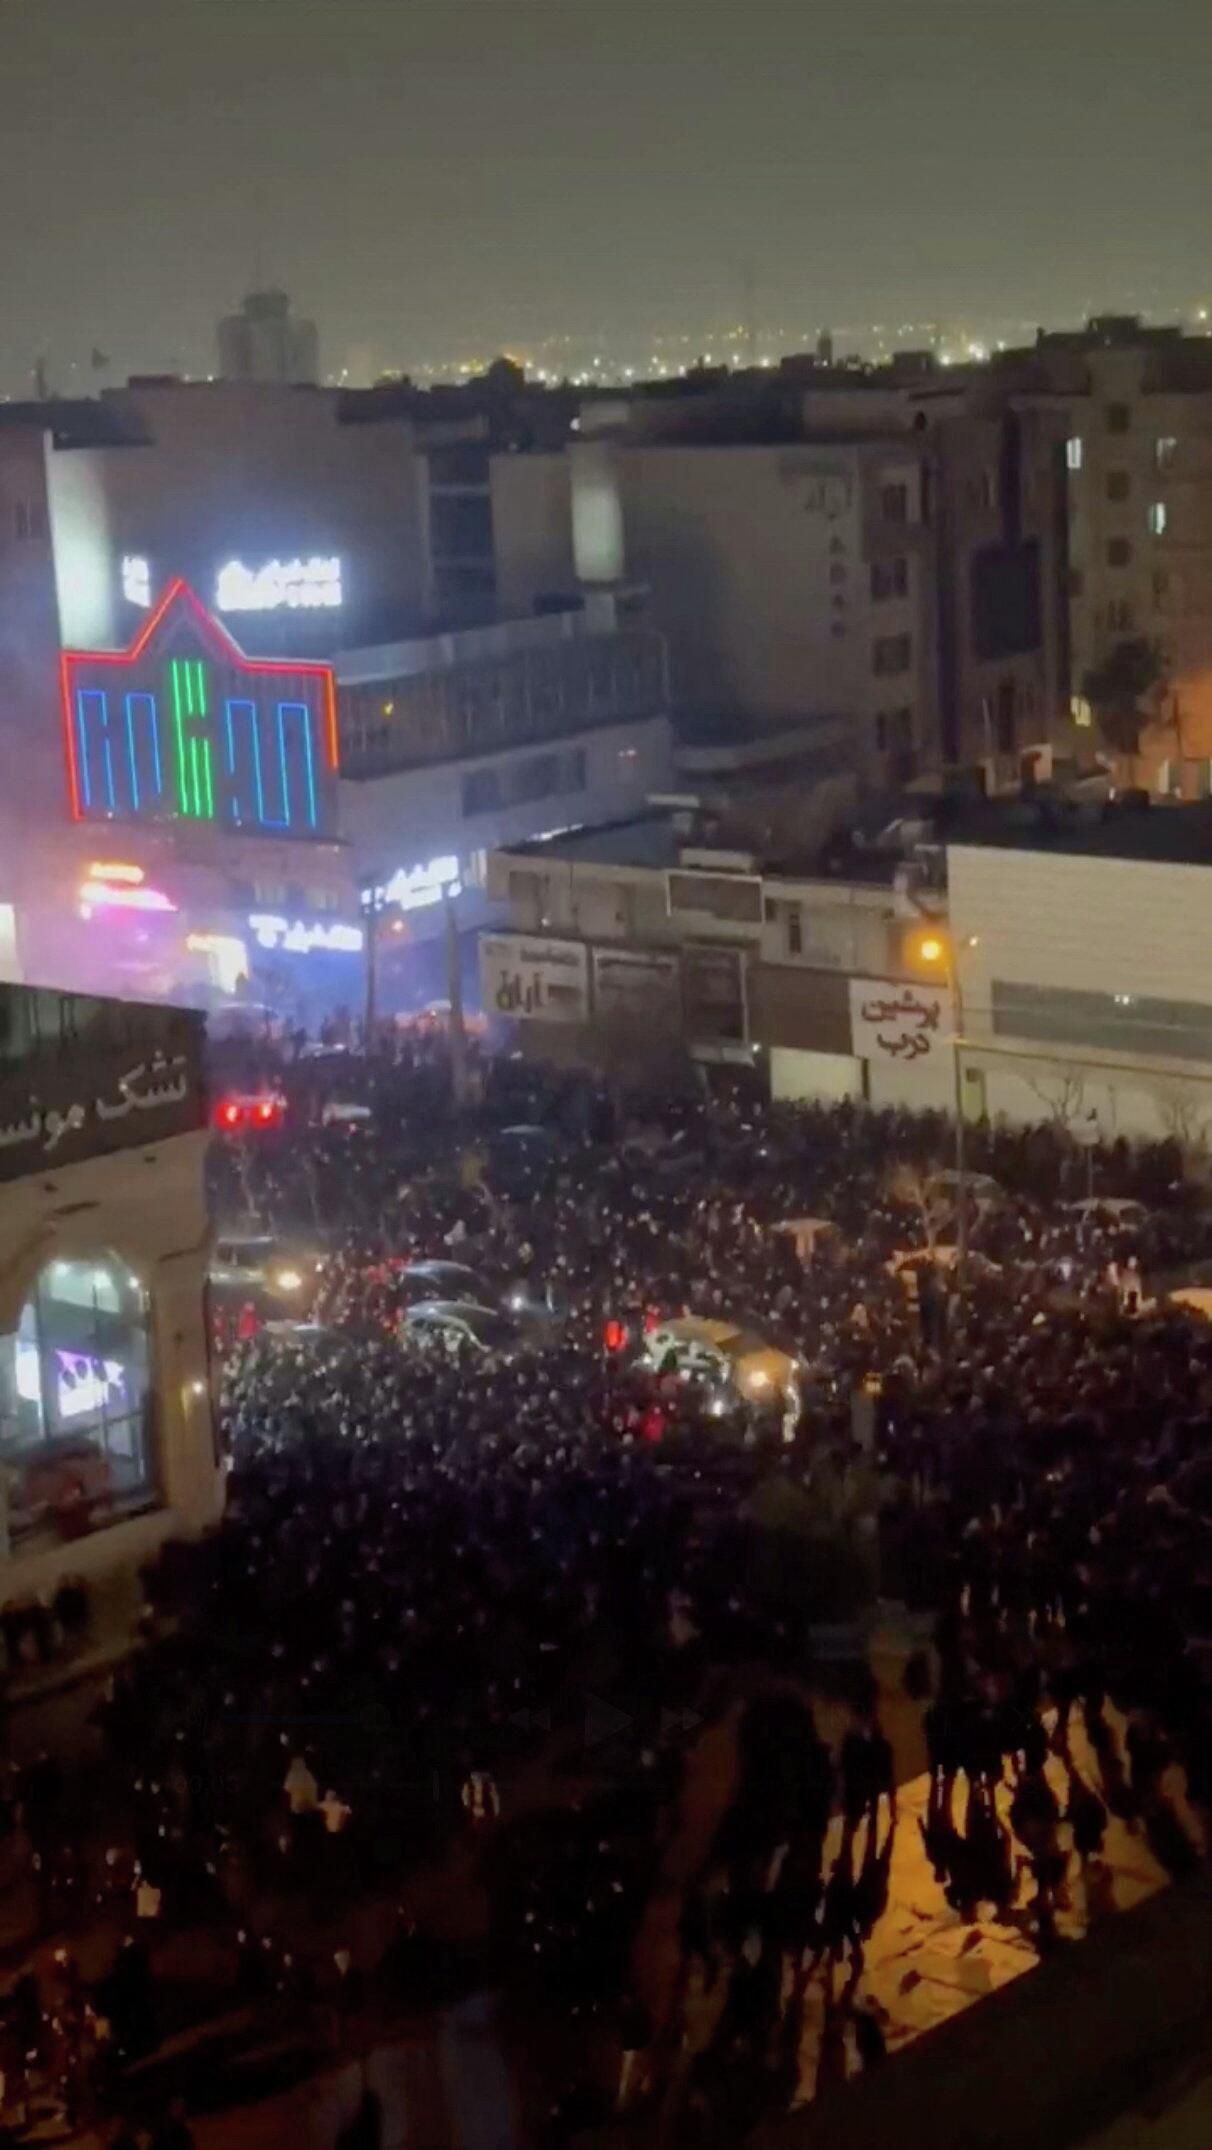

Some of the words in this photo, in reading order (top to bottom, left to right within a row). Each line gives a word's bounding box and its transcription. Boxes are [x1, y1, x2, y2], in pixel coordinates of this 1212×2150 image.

[862, 990, 941, 1030] پرشین
[876, 1033, 930, 1060] درب
[96, 1050, 187, 1120] تشک
